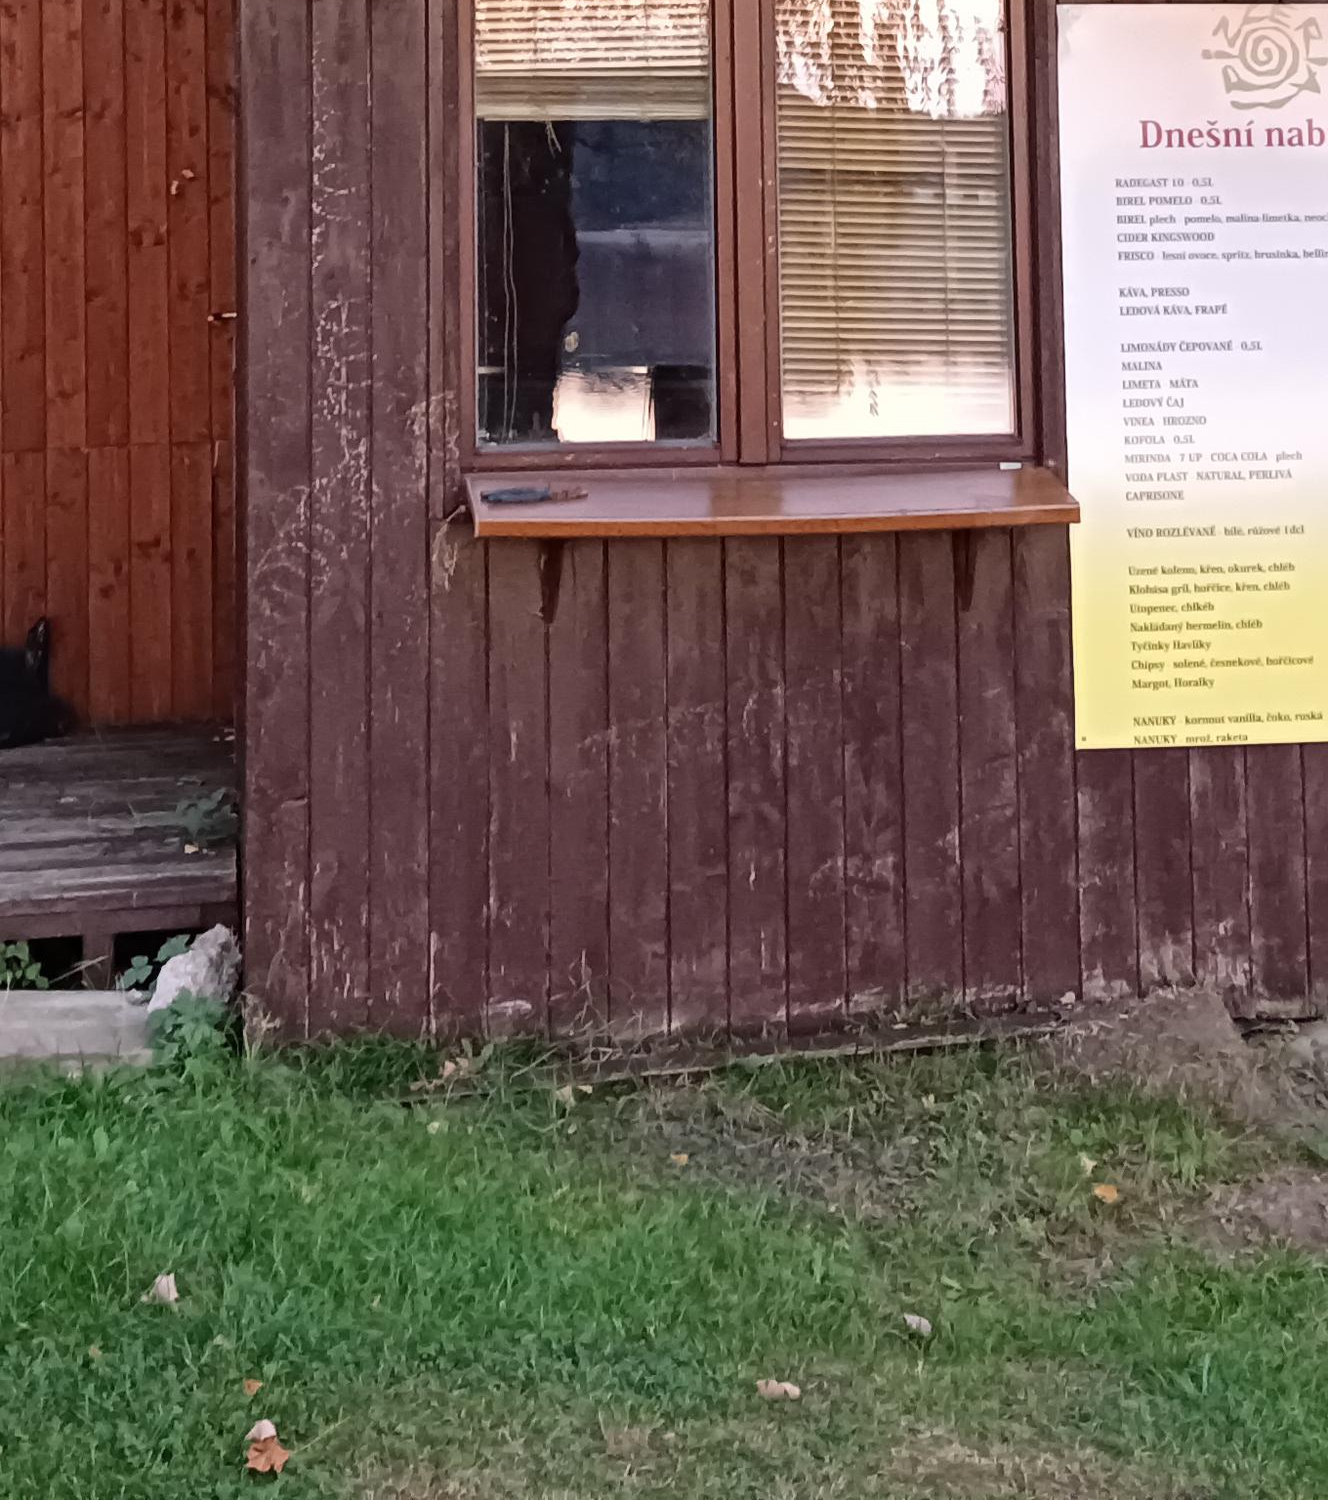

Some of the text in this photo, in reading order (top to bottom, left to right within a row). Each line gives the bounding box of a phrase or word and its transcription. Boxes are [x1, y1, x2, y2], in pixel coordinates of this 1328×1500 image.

[1139, 120, 1254, 148] Dnešní
[1115, 177, 1168, 188] RADEGAST
[1172, 177, 1184, 187] 10
[1115, 196, 1147, 206] BIREL
[1148, 195, 1192, 205] POMELO
[1116, 212, 1148, 224] BIREL
[1148, 214, 1176, 226] plech
[1116, 231, 1215, 243] CIDER KINGSWOOD
[1117, 250, 1155, 261] FRISCO
[1150, 286, 1190, 297] PRESSO
[1121, 360, 1162, 371] MALINA
[1122, 379, 1161, 389] LIMETA
[1124, 435, 1165, 445] KOFOLA
[1188, 452, 1202, 462] UP
[1240, 451, 1267, 461] COLA
[1275, 450, 1302, 462] plech
[1125, 472, 1154, 482] VODA
[1156, 471, 1188, 481] PLAST
[1125, 490, 1184, 501] CAPRISONE
[1133, 715, 1176, 726] NANUKY
[1133, 734, 1177, 744] NANUKY
